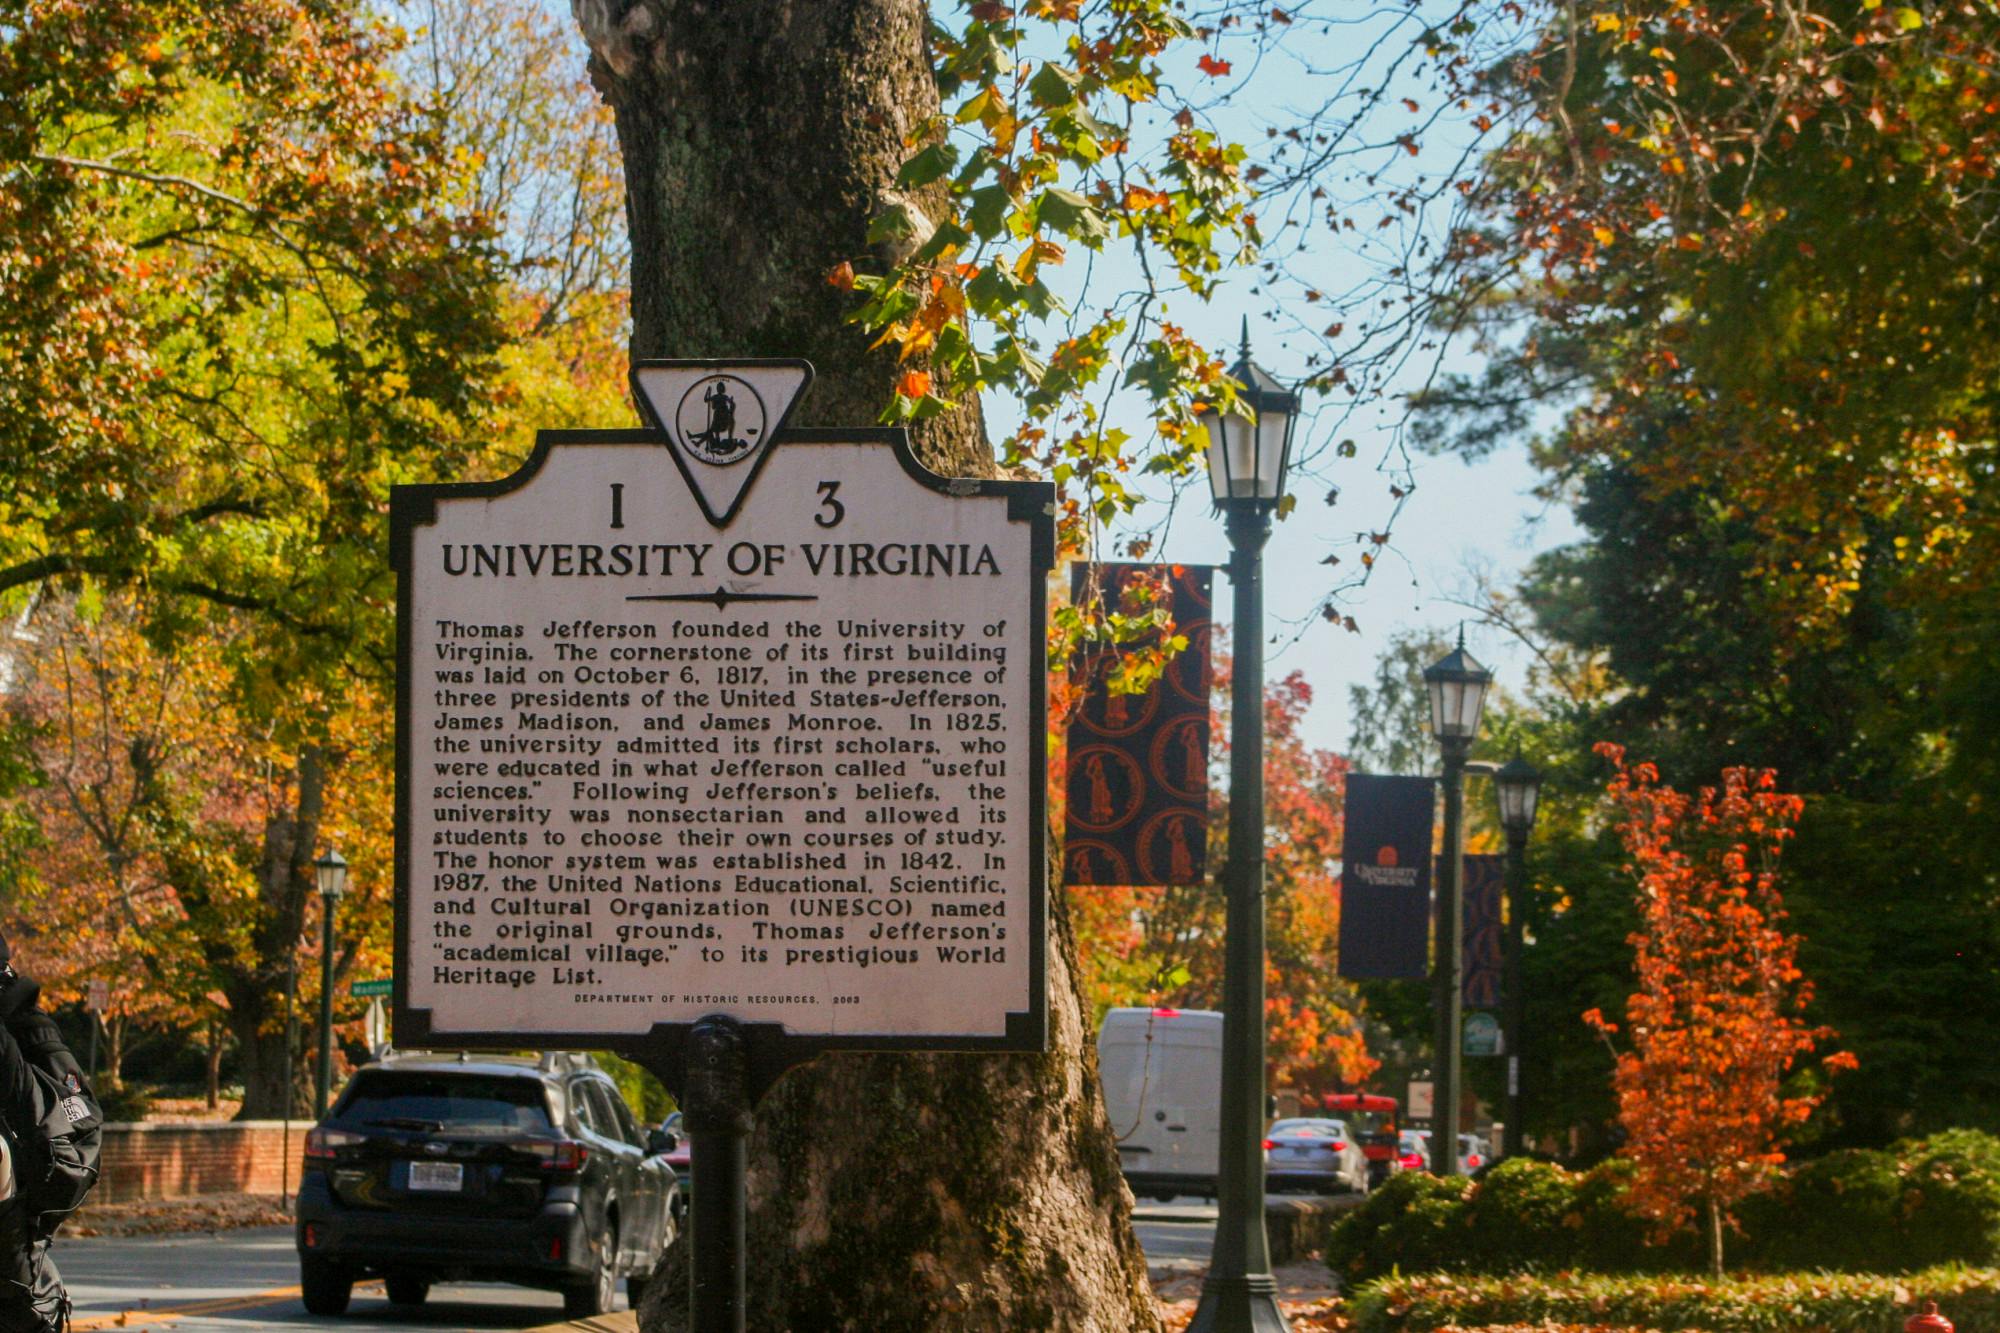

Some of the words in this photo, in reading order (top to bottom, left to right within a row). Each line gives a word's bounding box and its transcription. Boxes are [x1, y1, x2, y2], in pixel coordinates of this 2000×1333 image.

[813, 480, 846, 529] 3
[441, 543, 714, 578] UNIVERSITY
[726, 540, 786, 577] OF
[799, 542, 1003, 579] VIRGINIA
[435, 619, 525, 640] Thomas
[542, 619, 657, 640] Jefferson
[671, 619, 770, 640] founded
[784, 620, 823, 639] the
[836, 618, 966, 641] University
[982, 619, 1007, 638] of
[434, 640, 534, 667] Virginia.
[553, 642, 598, 662] The
[609, 644, 752, 662] cornerstone
[765, 642, 790, 663] of
[800, 642, 829, 662] its
[842, 641, 895, 662] first
[907, 641, 1007, 666] building
[434, 670, 475, 685] was
[483, 664, 527, 686] laid
[537, 669, 565, 685] on
[573, 665, 671, 686] October
[679, 665, 700, 686] 6,
[717, 665, 769, 686] 1817,
[787, 665, 809, 686] in
[819, 666, 857, 686] the
[866, 669, 973, 689] presence
[983, 665, 1007, 685] of
[433, 688, 497, 708] three
[510, 688, 631, 711] presidents
[641, 688, 666, 708] of
[672, 689, 710, 708] the
[719, 688, 796, 709] United
[433, 711, 504, 732] James
[517, 711, 619, 733] Madison,
[643, 713, 685, 732] and
[699, 712, 771, 733] James
[787, 712, 883, 733] Monroe.
[909, 713, 933, 731] In
[946, 712, 1007, 732] 1825,
[433, 735, 471, 754] the
[479, 733, 603, 757] university
[616, 734, 720, 755] admitted
[733, 734, 761, 755] its
[773, 735, 824, 755] first
[834, 736, 941, 755] scholars,
[959, 736, 1007, 755] who
[433, 762, 489, 777] were
[496, 759, 601, 779] educated
[611, 757, 634, 779] in
[643, 759, 699, 778] what
[710, 758, 824, 778] Jefferson
[834, 759, 906, 778] called
[572, 781, 690, 805] Following
[705, 781, 839, 802] Jefferson's
[855, 780, 940, 802] beliefs,
[967, 782, 1006, 801] the
[433, 803, 552, 827] university
[569, 809, 611, 825] was
[627, 804, 784, 825] nonsectarian
[804, 806, 847, 825] and
[864, 806, 960, 825] allowed
[979, 803, 1007, 825] its
[432, 828, 529, 847] students
[543, 829, 566, 847] to
[580, 828, 663, 848] choose
[677, 827, 735, 848] their
[745, 832, 792, 849] own
[803, 832, 894, 849] courses
[903, 827, 928, 846] of
[935, 828, 1006, 849] study.
[432, 849, 478, 870] The
[488, 850, 554, 870] honor
[565, 852, 647, 874] system
[655, 855, 698, 870] was
[712, 850, 847, 871] established
[863, 850, 887, 871] in
[900, 851, 962, 871] 1842.
[983, 852, 1006, 871] In
[433, 872, 489, 893] 1987,
[500, 874, 538, 894] the
[547, 873, 623, 894] United
[634, 873, 722, 894] Nations
[734, 874, 873, 895] Educational,
[889, 873, 1007, 895] Scientific,
[433, 896, 477, 916] and
[490, 896, 591, 917] Cultural
[609, 897, 770, 921] Organization
[789, 897, 913, 919] (UNESCO)
[930, 900, 1006, 918] named
[432, 920, 472, 939] the
[495, 919, 593, 945] original
[615, 922, 723, 945] grounds,
[751, 920, 845, 941] Thomas
[868, 920, 1007, 941] Jefferson's
[700, 945, 725, 963] to
[741, 944, 769, 964] its
[785, 944, 919, 969] prestigious
[935, 945, 1006, 964] World
[432, 965, 537, 989] Heritage
[552, 967, 603, 986] List.
[574, 993, 654, 1004] DEPARTMENT
[661, 994, 676, 1004] OF
[683, 994, 739, 1004] HISTORIC
